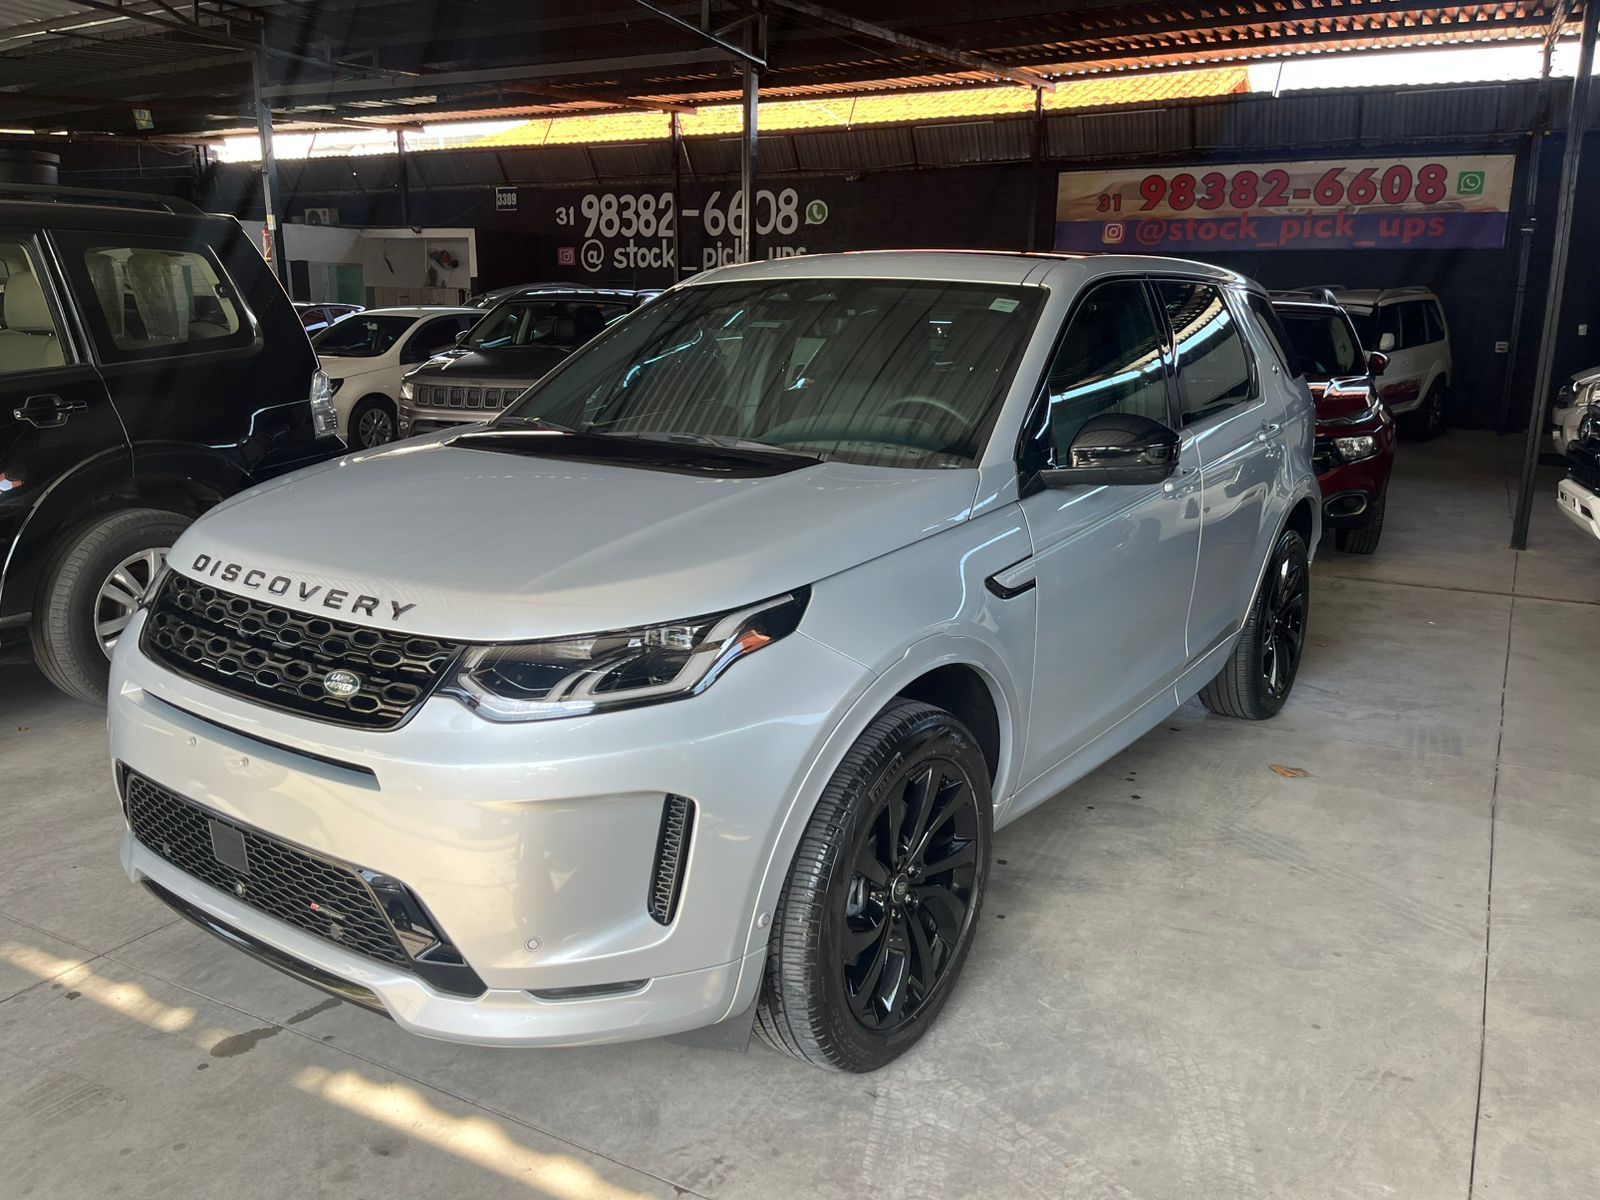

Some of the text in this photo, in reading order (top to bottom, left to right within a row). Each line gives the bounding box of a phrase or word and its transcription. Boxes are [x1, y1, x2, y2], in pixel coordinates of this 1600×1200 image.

[1096, 163, 1448, 212] 31 98382-6608
[555, 206, 575, 226] 31
[1135, 208, 1446, 247] @stock_pick_ups
[191, 553, 417, 622] DISCOVERY
